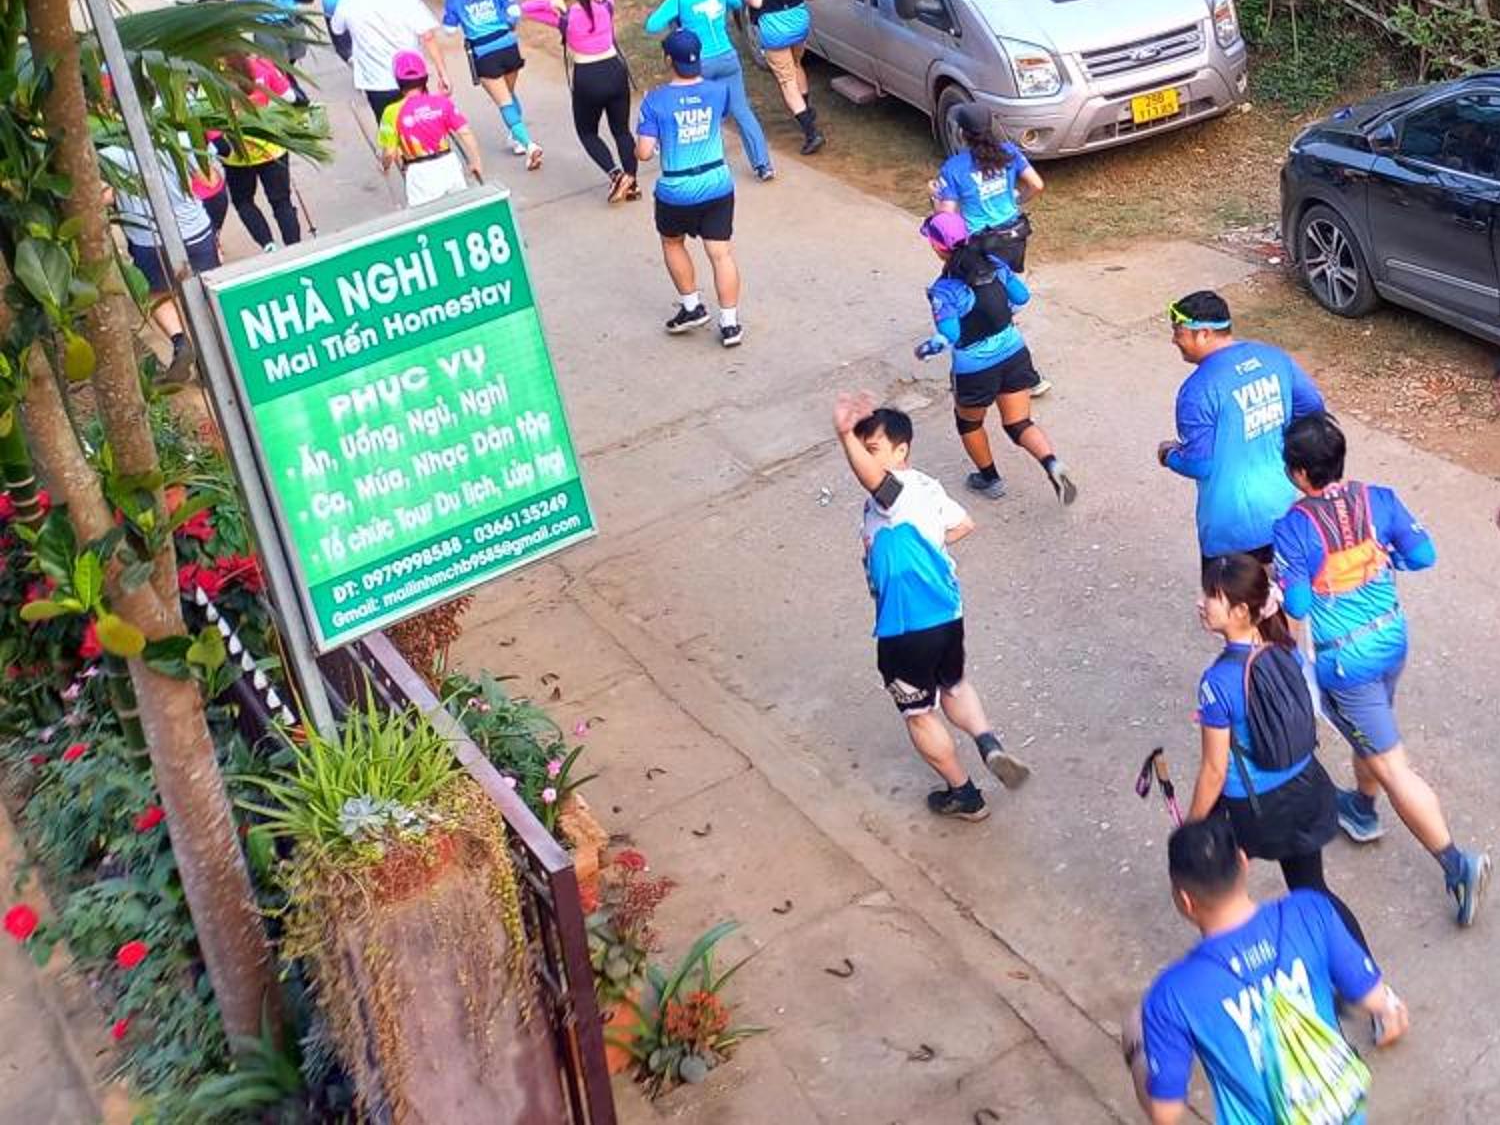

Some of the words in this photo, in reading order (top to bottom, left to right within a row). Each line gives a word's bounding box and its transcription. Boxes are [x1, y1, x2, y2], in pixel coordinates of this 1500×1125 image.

[239, 277, 334, 350] NHÀ
[336, 234, 439, 316] NGHỈ
[444, 224, 511, 277] 188
[263, 345, 318, 383] Mai
[321, 321, 379, 362] Tiến
[383, 280, 512, 340] Homestay
[332, 580, 360, 604] ĐT:
[473, 492, 568, 543] 0366135249
[332, 597, 381, 628] Gmail:
